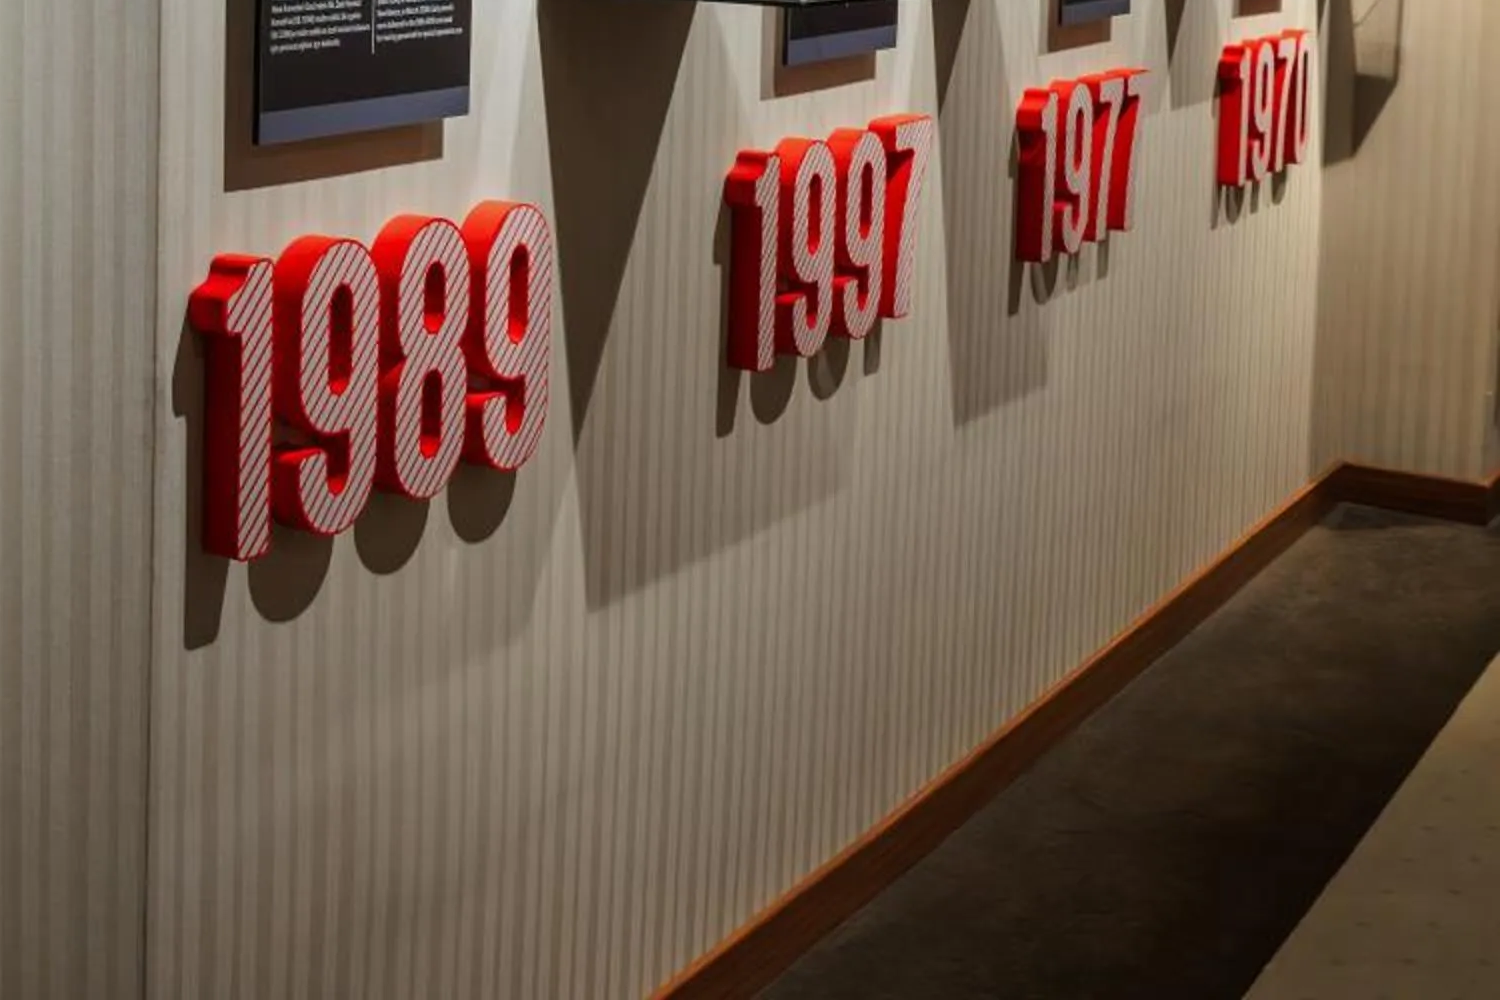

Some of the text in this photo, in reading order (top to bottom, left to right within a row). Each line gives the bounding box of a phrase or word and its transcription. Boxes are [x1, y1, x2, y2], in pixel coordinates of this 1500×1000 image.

[1217, 28, 1317, 187] 1970
[724, 113, 934, 372] 1997
[188, 199, 552, 562] 1989
